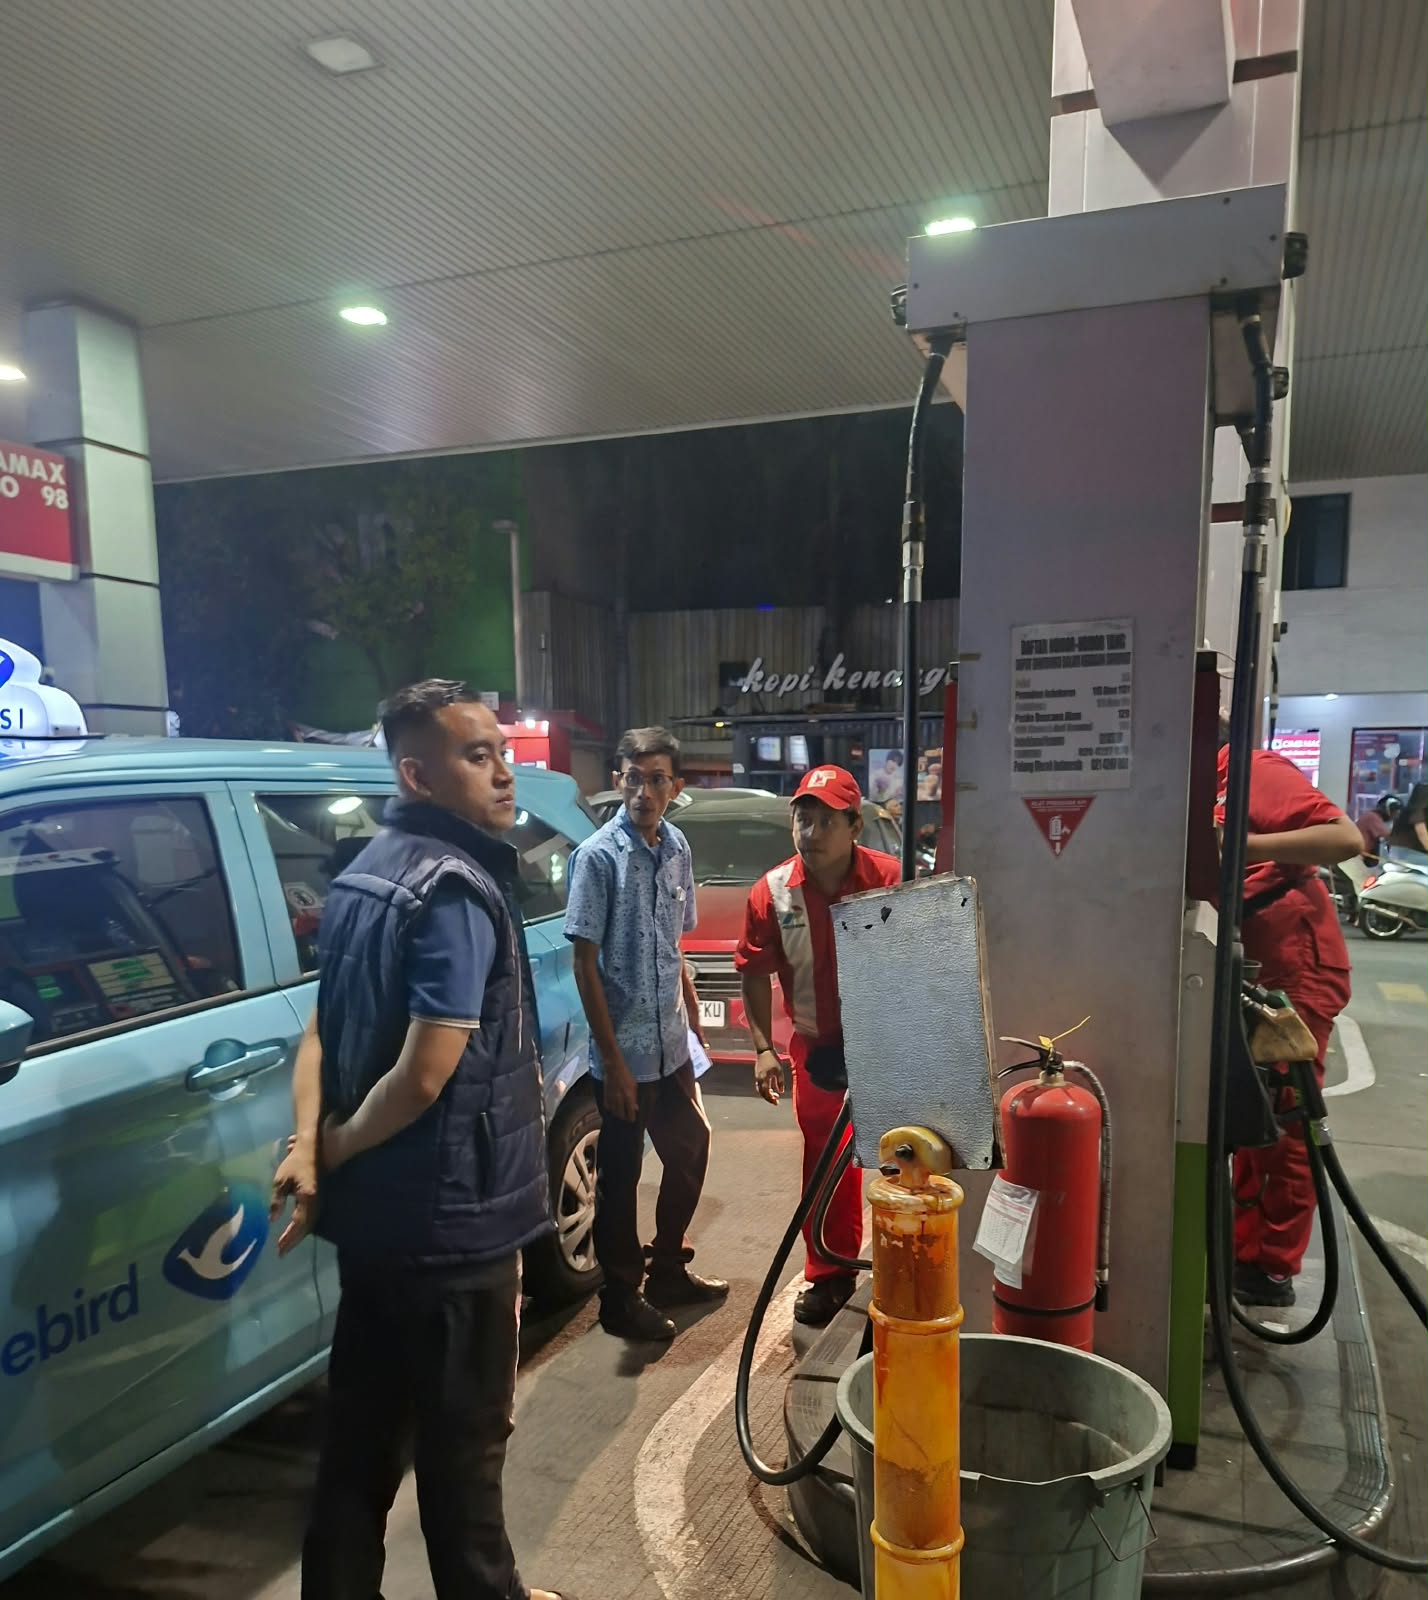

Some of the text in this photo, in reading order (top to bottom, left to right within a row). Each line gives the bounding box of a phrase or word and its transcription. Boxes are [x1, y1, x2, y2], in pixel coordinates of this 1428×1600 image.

[40, 486, 70, 509] 98
[741, 657, 815, 697] kopi
[1, 1262, 139, 1376] ebird
